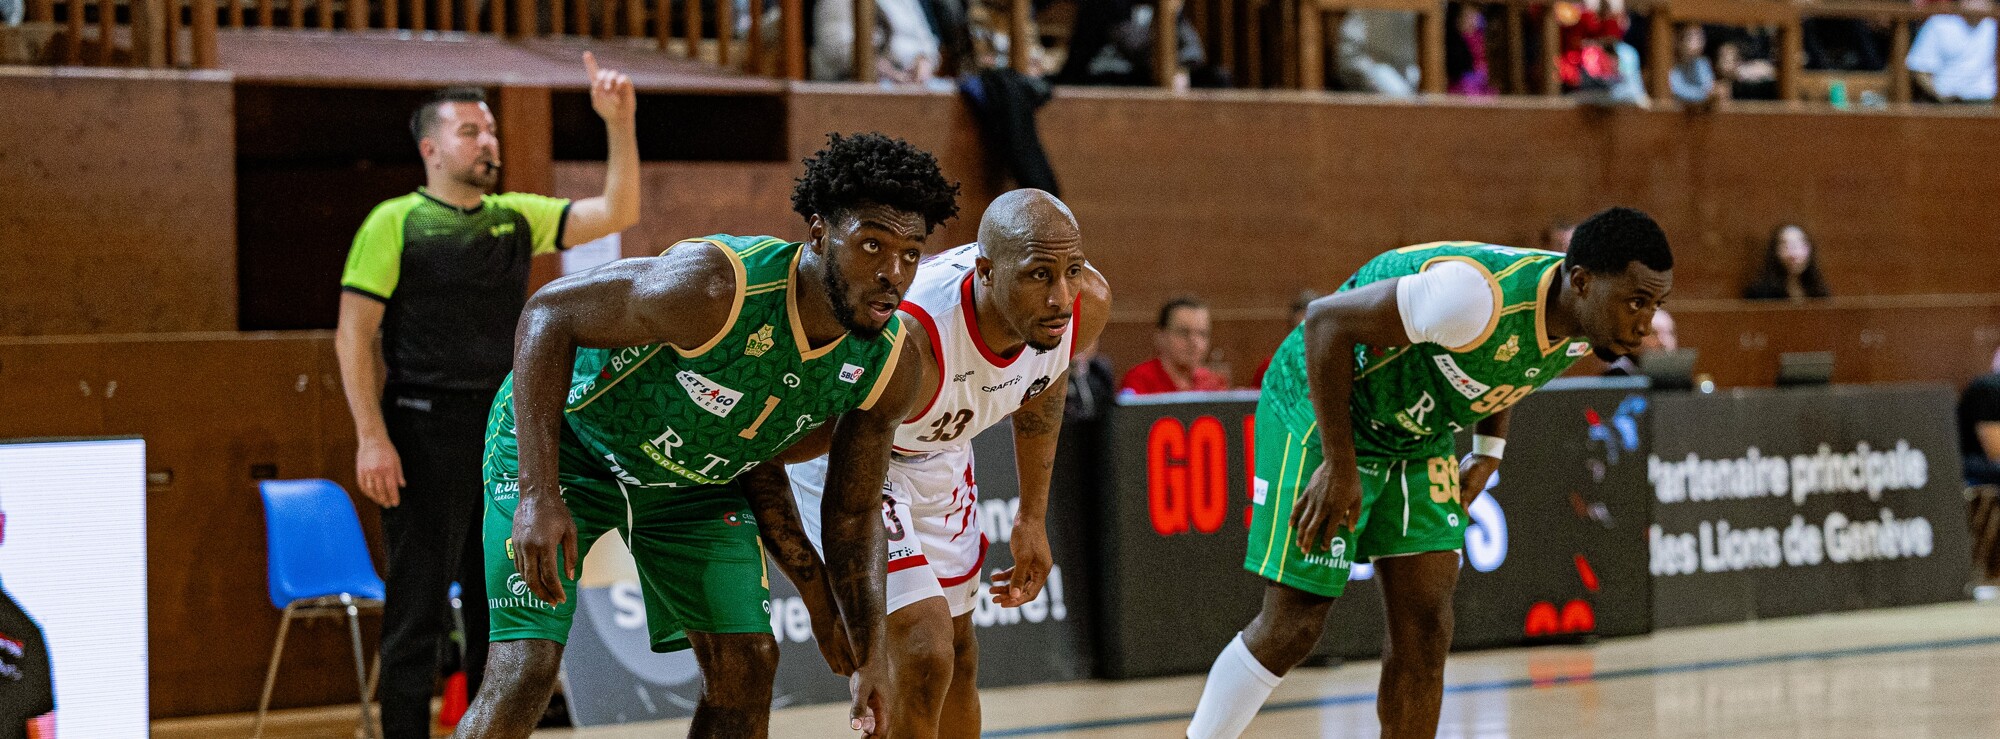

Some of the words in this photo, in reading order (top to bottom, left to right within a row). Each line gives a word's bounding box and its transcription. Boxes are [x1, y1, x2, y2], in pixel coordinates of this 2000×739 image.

[715, 395, 735, 407] GO
[981, 378, 1016, 393] CRAFT
[1470, 384, 1533, 413] 99
[737, 394, 782, 440] 1
[916, 408, 975, 443] 33
[1147, 415, 1228, 536] GO
[1427, 455, 1461, 504] 99
[1790, 439, 1930, 506] principale
[1699, 519, 1782, 573] Lions
[1782, 514, 1824, 567] de
[1823, 506, 1934, 563] Genève
